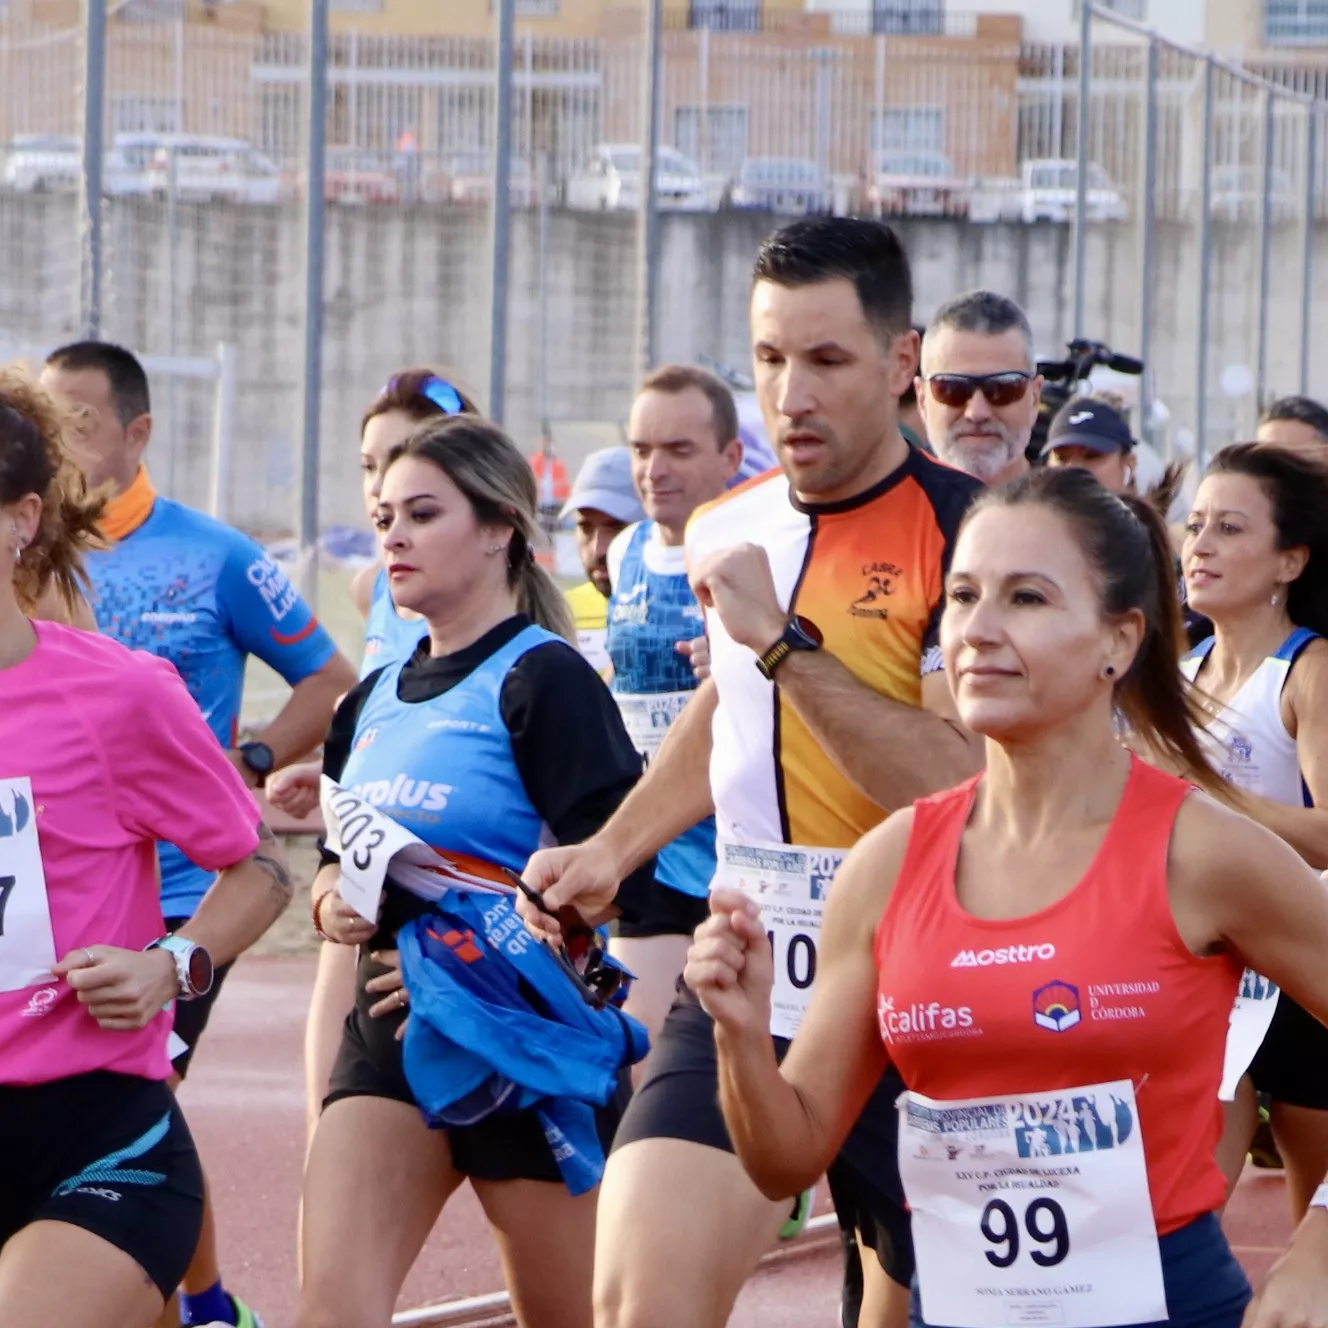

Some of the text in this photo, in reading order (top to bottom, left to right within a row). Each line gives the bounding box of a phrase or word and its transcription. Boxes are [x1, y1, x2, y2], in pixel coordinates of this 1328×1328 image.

[1087, 981, 1160, 997] UNIVERSIDAD
[1007, 1098, 1077, 1128] 2024
[980, 1197, 1070, 1268] 99
